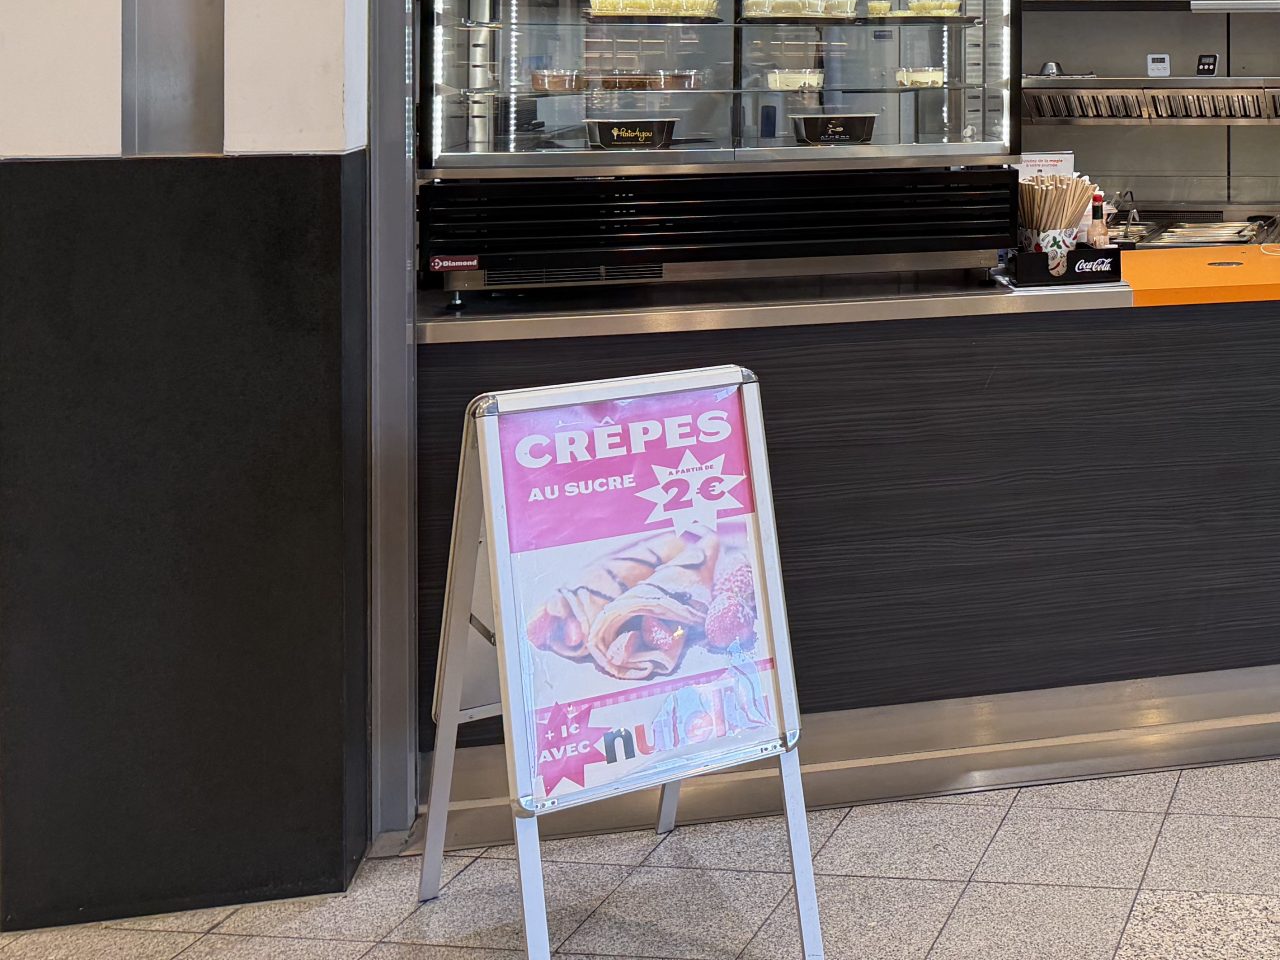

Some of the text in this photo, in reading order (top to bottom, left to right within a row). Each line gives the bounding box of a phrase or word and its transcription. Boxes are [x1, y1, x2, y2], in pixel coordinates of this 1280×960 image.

[442, 259, 478, 267] Diamond
[1075, 258, 1113, 273] Coca-Cola
[515, 410, 732, 469] CRÊPES
[675, 465, 703, 476] PARTIR
[528, 474, 637, 503] AU SUCRE
[538, 740, 591, 763] AVEC
